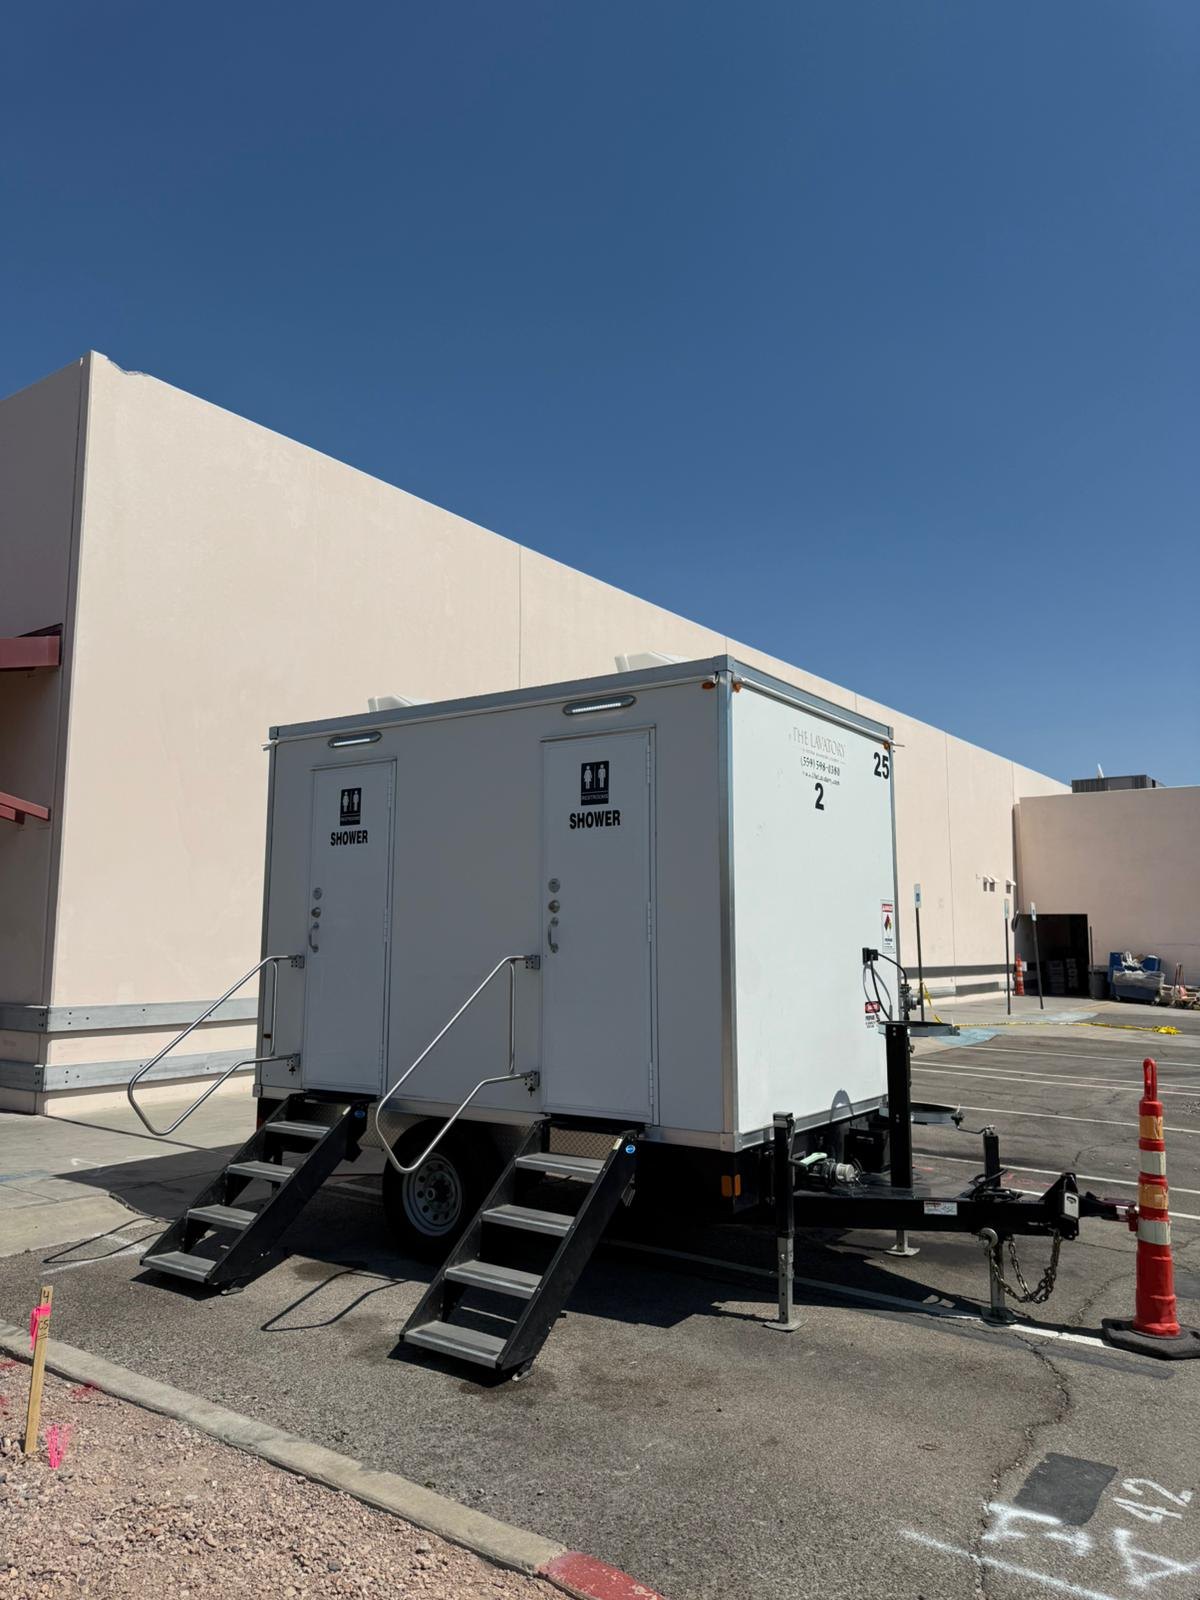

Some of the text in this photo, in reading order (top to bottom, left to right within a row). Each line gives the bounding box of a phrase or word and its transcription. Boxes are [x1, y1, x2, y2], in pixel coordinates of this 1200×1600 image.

[793, 726, 808, 746] THE
[810, 732, 845, 758] LAVATORY
[873, 752, 889, 779] 25
[814, 782, 824, 811] 2
[569, 809, 621, 829] SHOWER
[330, 829, 368, 846] SHOWER
[1112, 1477, 1194, 1524] 42
